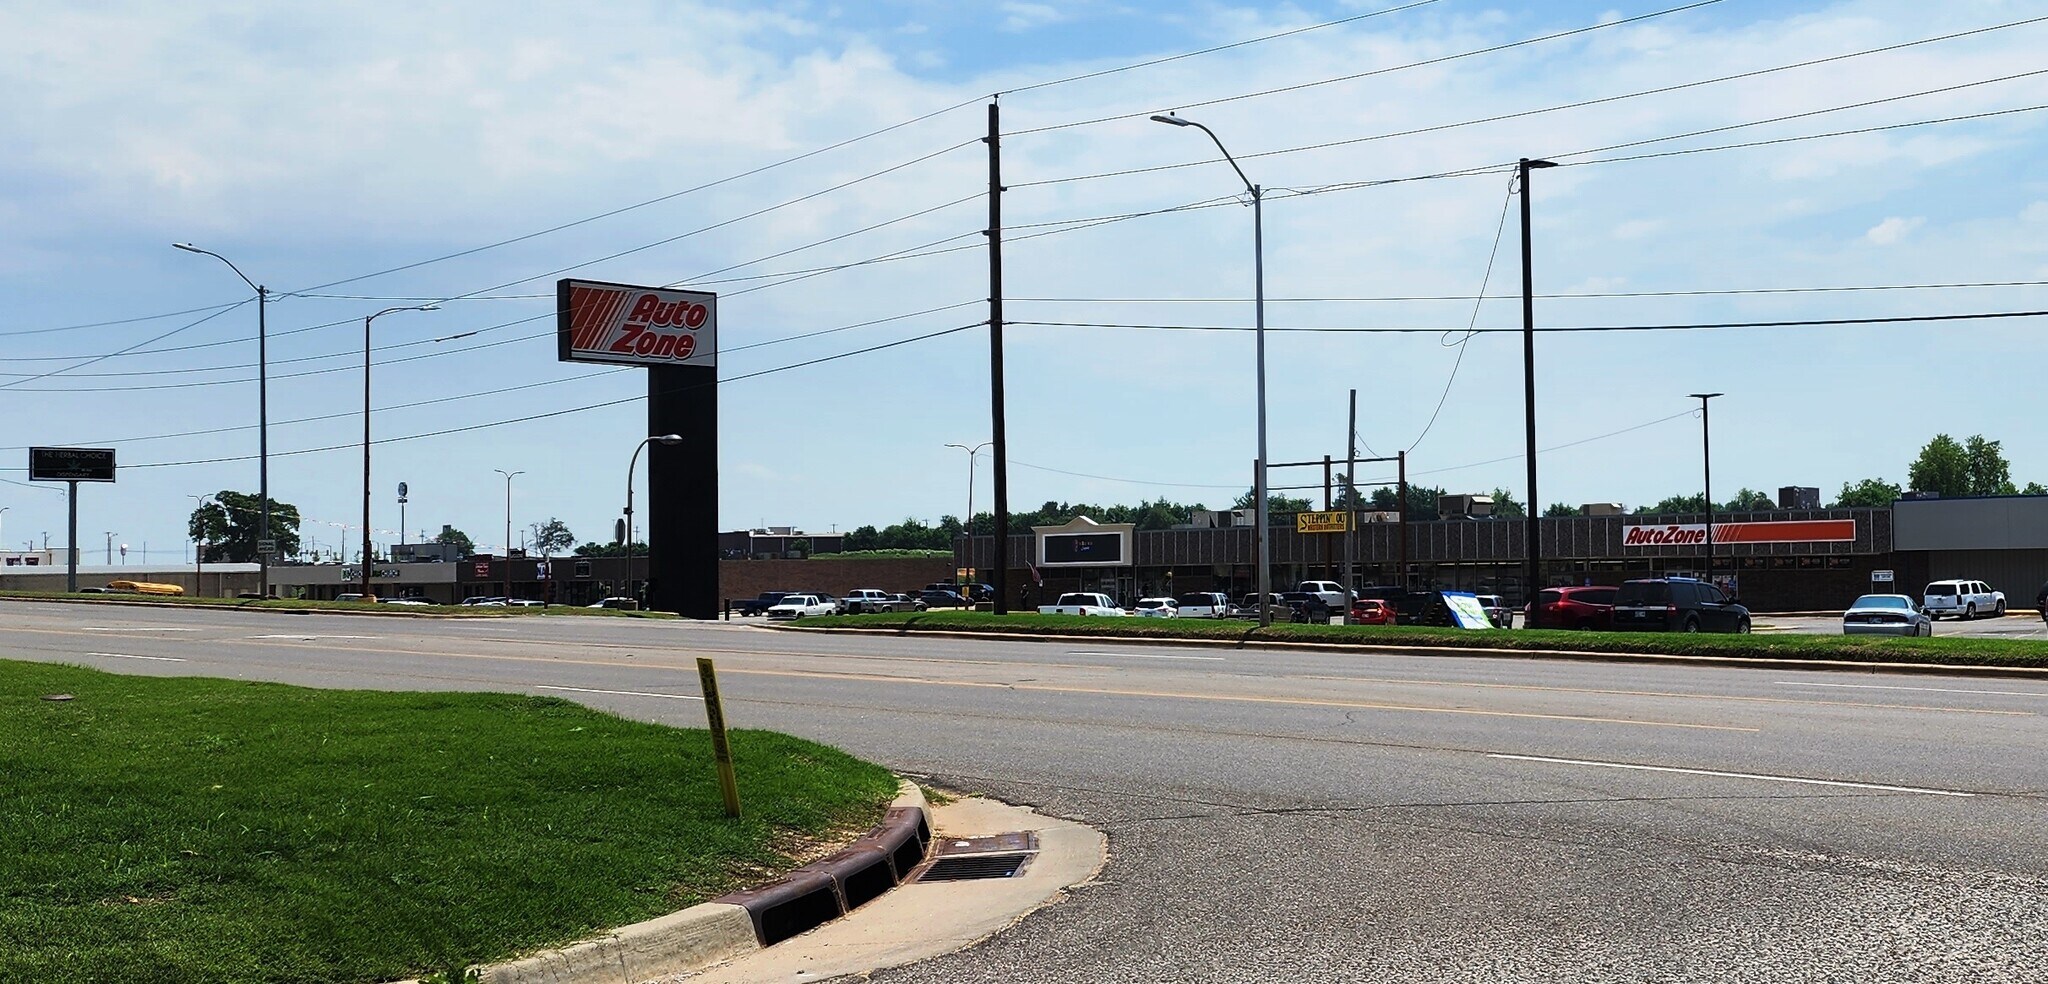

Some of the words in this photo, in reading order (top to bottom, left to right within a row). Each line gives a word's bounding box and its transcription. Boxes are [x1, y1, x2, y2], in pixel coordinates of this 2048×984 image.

[628, 293, 707, 329] Auto
[610, 323, 696, 360] Zone
[1625, 526, 1705, 544] AutoZone
